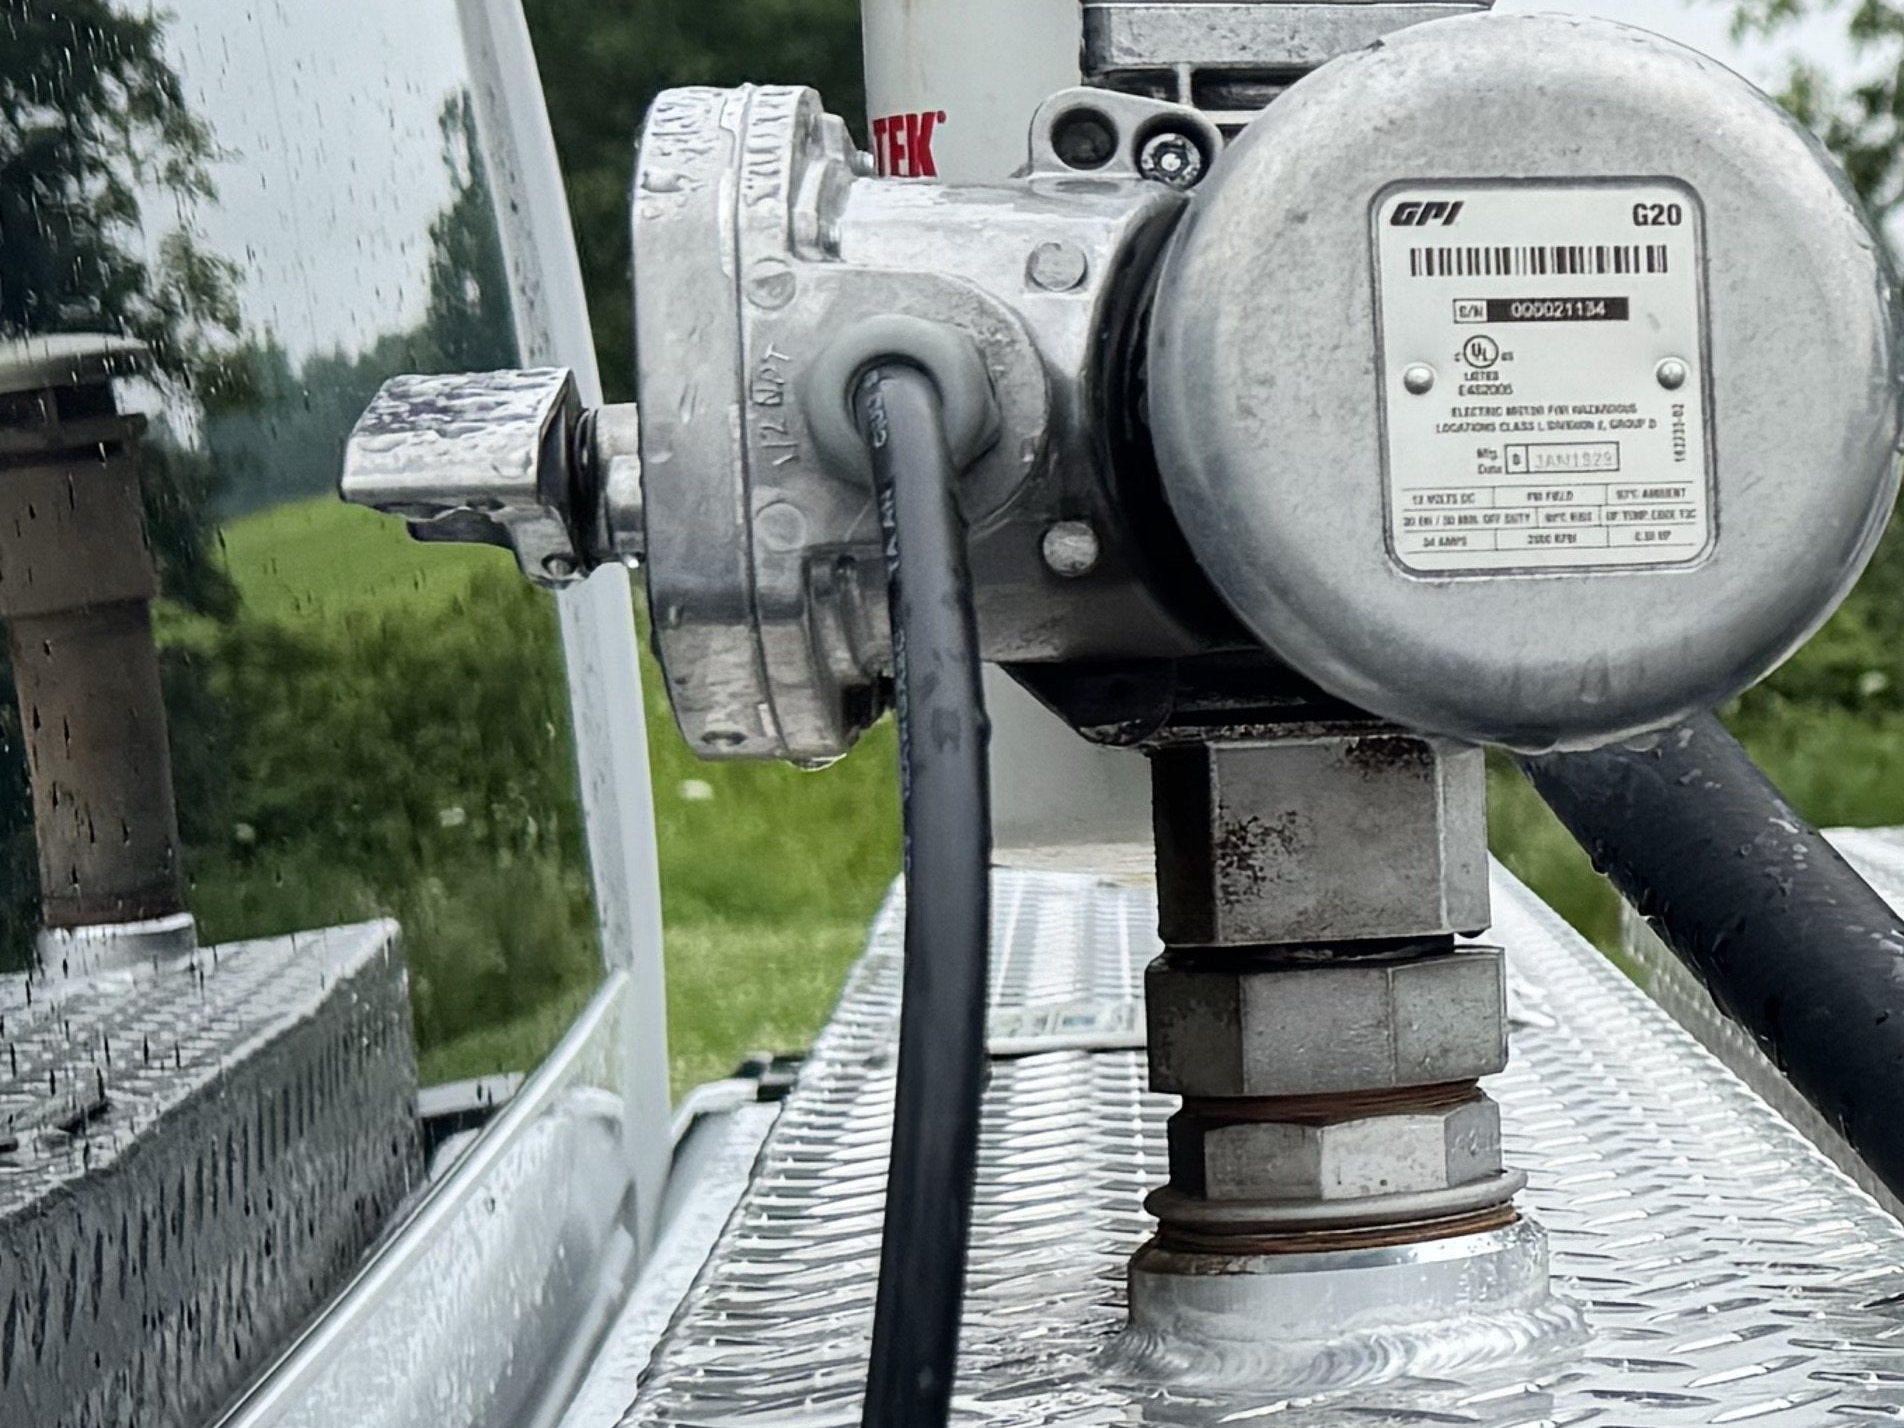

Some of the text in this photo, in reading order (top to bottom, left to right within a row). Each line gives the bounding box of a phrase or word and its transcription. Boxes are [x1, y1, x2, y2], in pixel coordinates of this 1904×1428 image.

[1390, 201, 1464, 227] GPI
[1633, 203, 1682, 227] G20
[1451, 406, 1503, 418] ELECTRIC
[1436, 422, 1497, 433] LOCATIONS
[1500, 421, 1535, 432] CLASS
